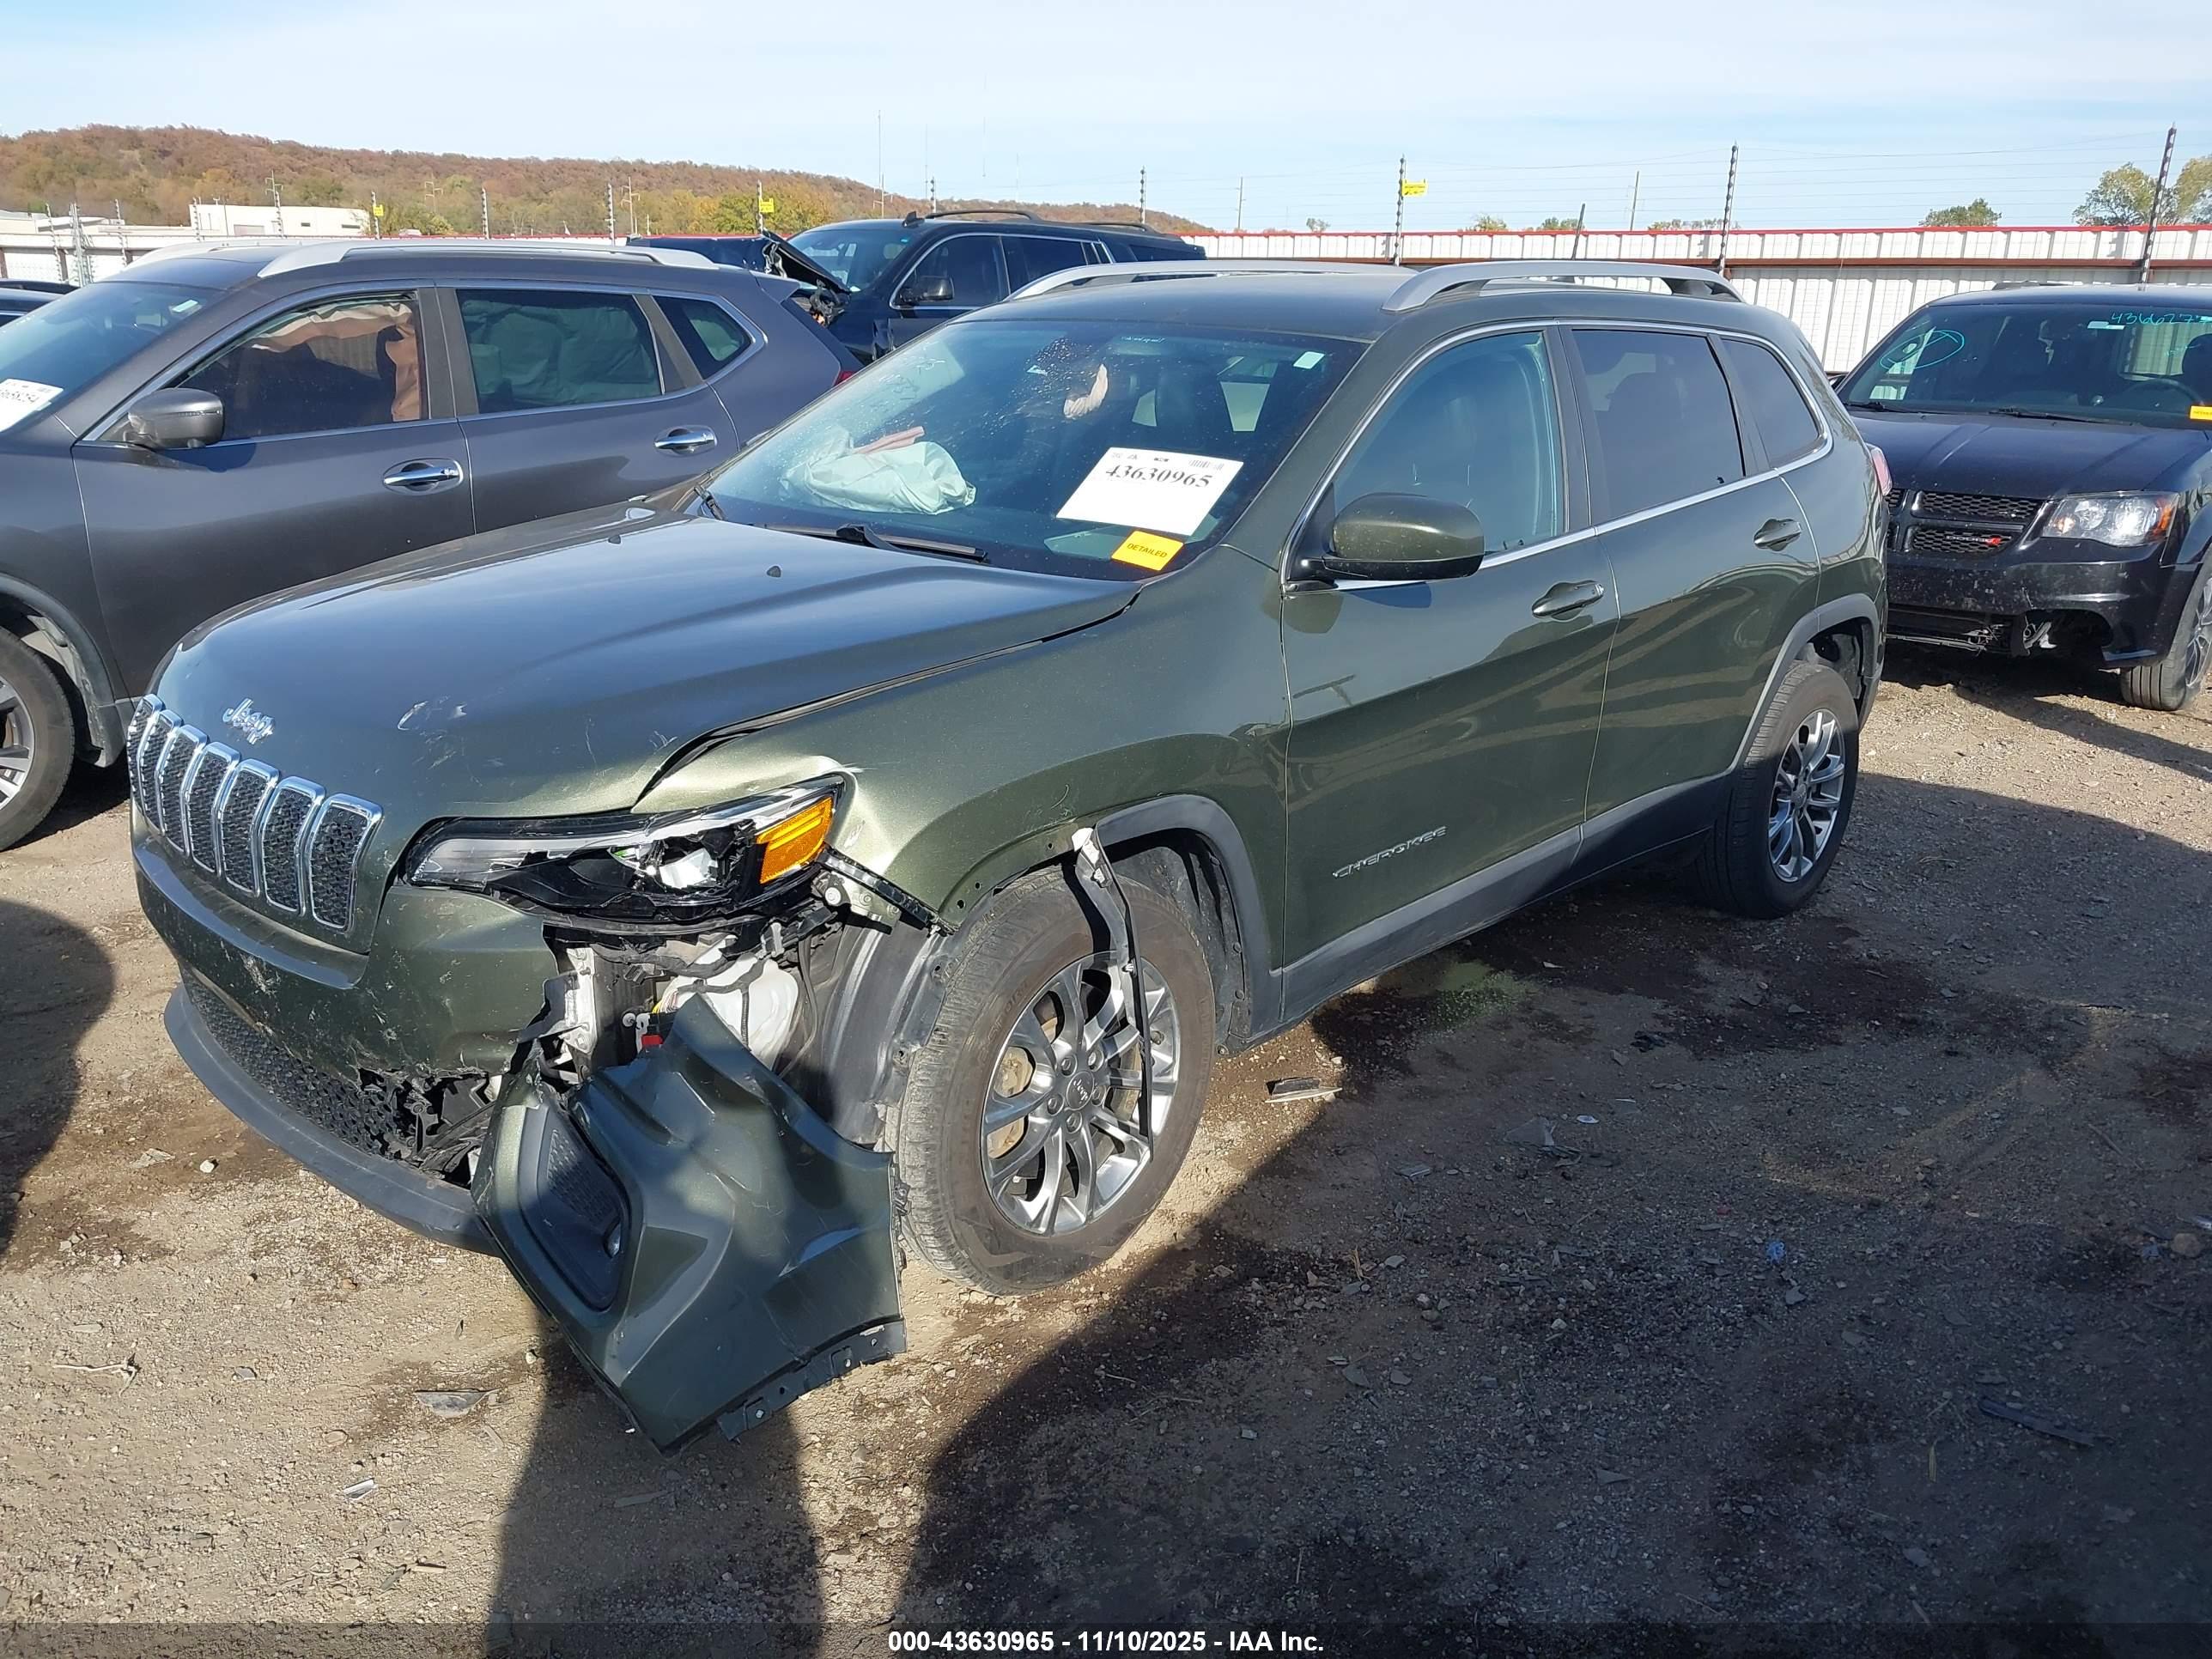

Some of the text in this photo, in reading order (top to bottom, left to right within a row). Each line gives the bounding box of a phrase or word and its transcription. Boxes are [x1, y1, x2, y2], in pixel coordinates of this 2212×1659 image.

[1105, 465, 1213, 488] 43630965
[1127, 543, 1168, 559] DETAILED
[222, 697, 274, 744] Jeep
